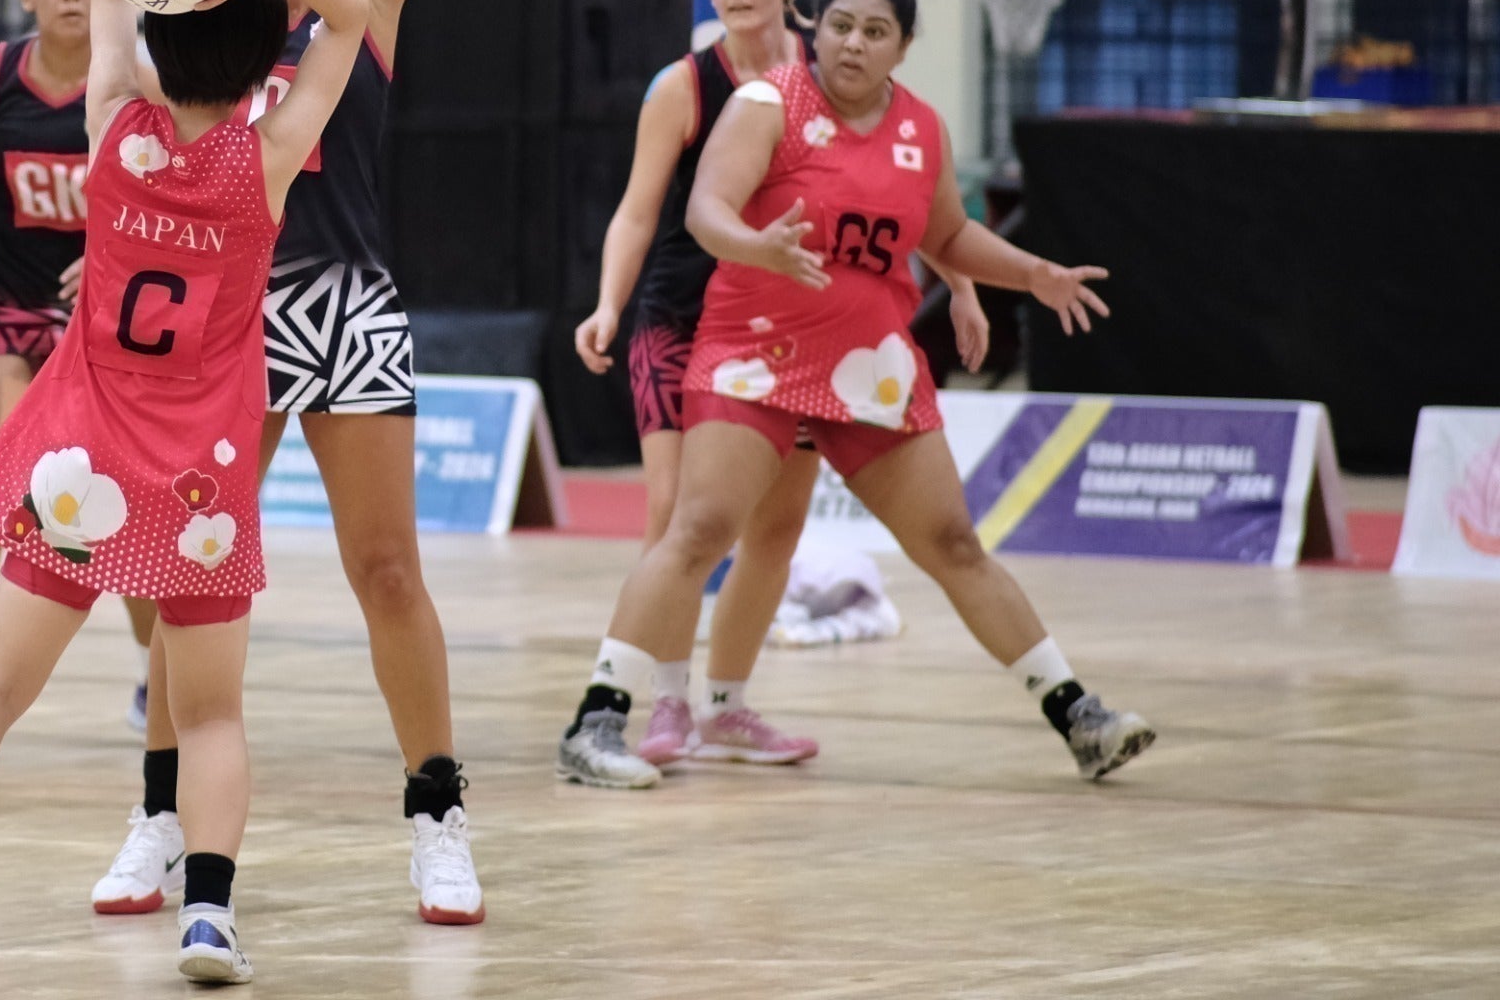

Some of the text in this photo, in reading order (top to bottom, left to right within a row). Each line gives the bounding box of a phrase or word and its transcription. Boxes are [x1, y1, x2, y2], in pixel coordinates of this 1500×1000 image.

[113, 205, 228, 253] JAPAN
[831, 212, 900, 275] GS
[116, 270, 188, 356] C
